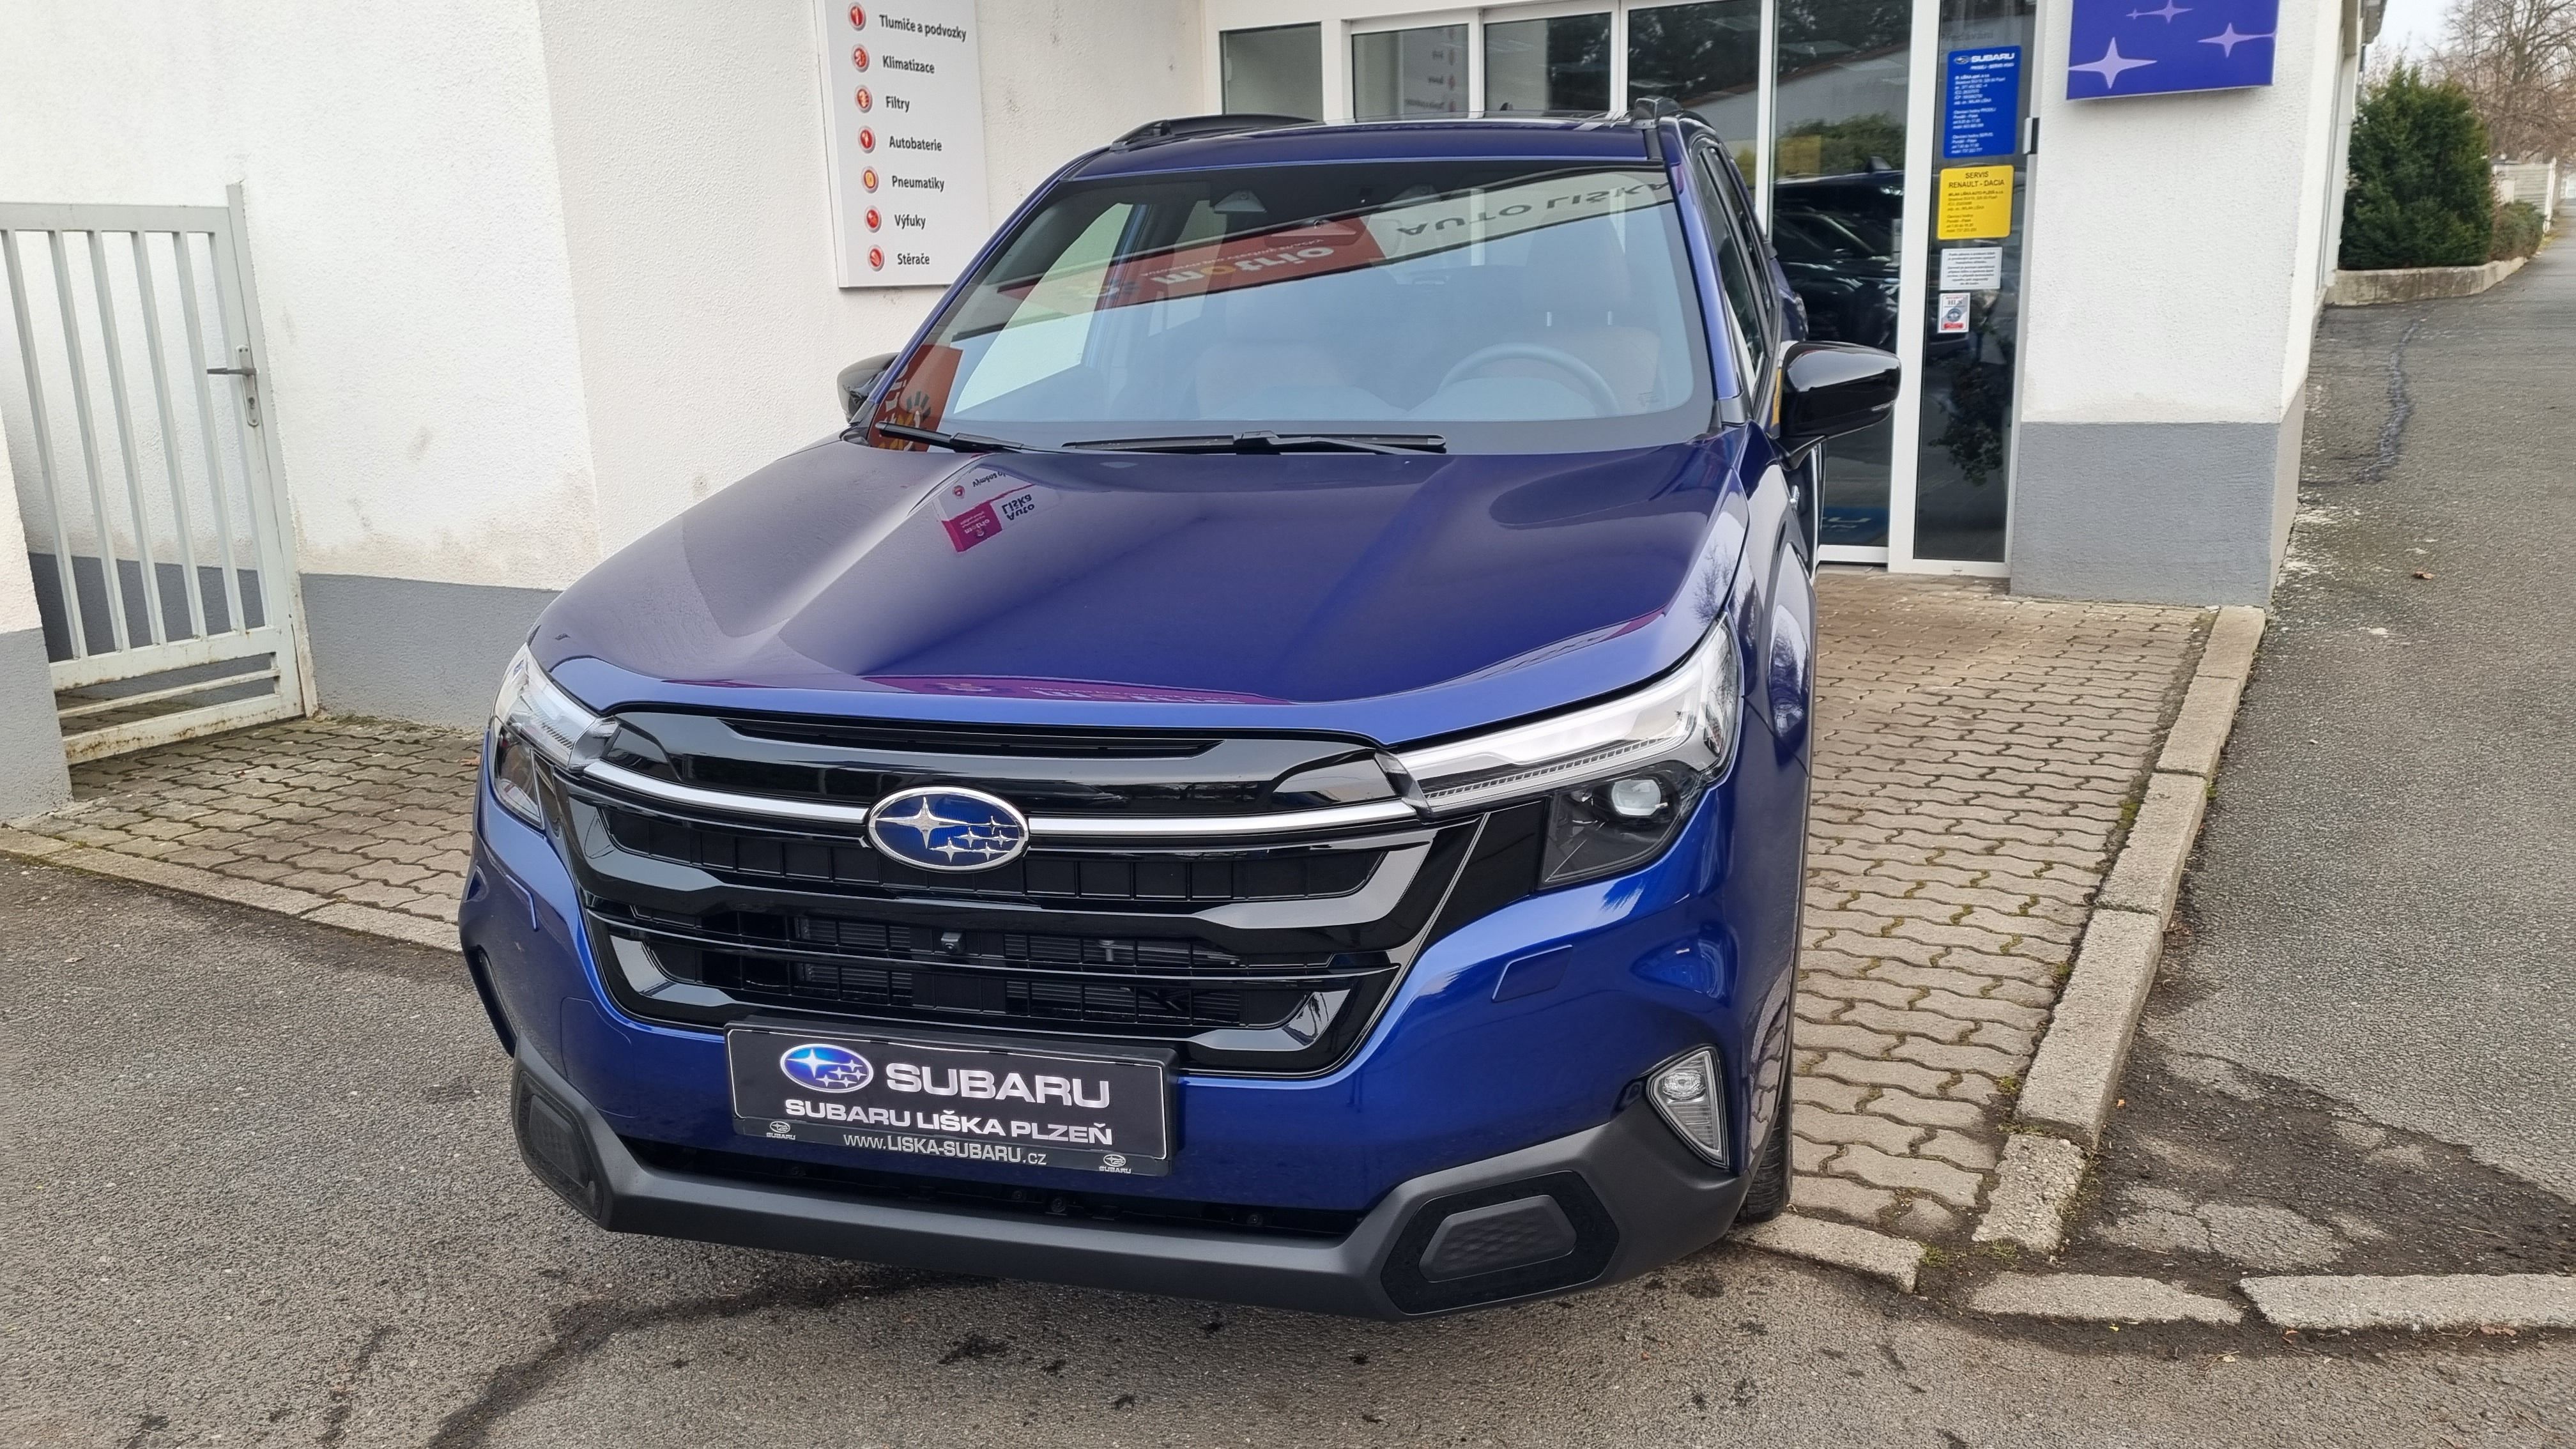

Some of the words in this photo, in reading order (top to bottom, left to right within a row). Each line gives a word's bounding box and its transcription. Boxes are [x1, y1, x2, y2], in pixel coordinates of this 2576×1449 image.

[879, 14, 916, 32] Tlumiče
[917, 24, 923, 33] a
[924, 23, 967, 42] podvozky
[882, 55, 935, 74] Klimatizace
[1970, 52, 2015, 63] SUBARU
[885, 96, 910, 113] Filtry
[889, 135, 942, 151] Autobaterie
[892, 175, 945, 192] Pneumatiky
[894, 213, 926, 230] Výfuky
[897, 253, 930, 266] Stěrače
[885, 1062, 1110, 1108] SUBARU
[785, 1099, 911, 1127] SUBARU
[917, 1109, 1006, 1137] LIŠKA
[1011, 1122, 1113, 1146] PLZEŇ
[766, 1132, 796, 1140] SUBARU
[1099, 1166, 1131, 1174] SUBARU
